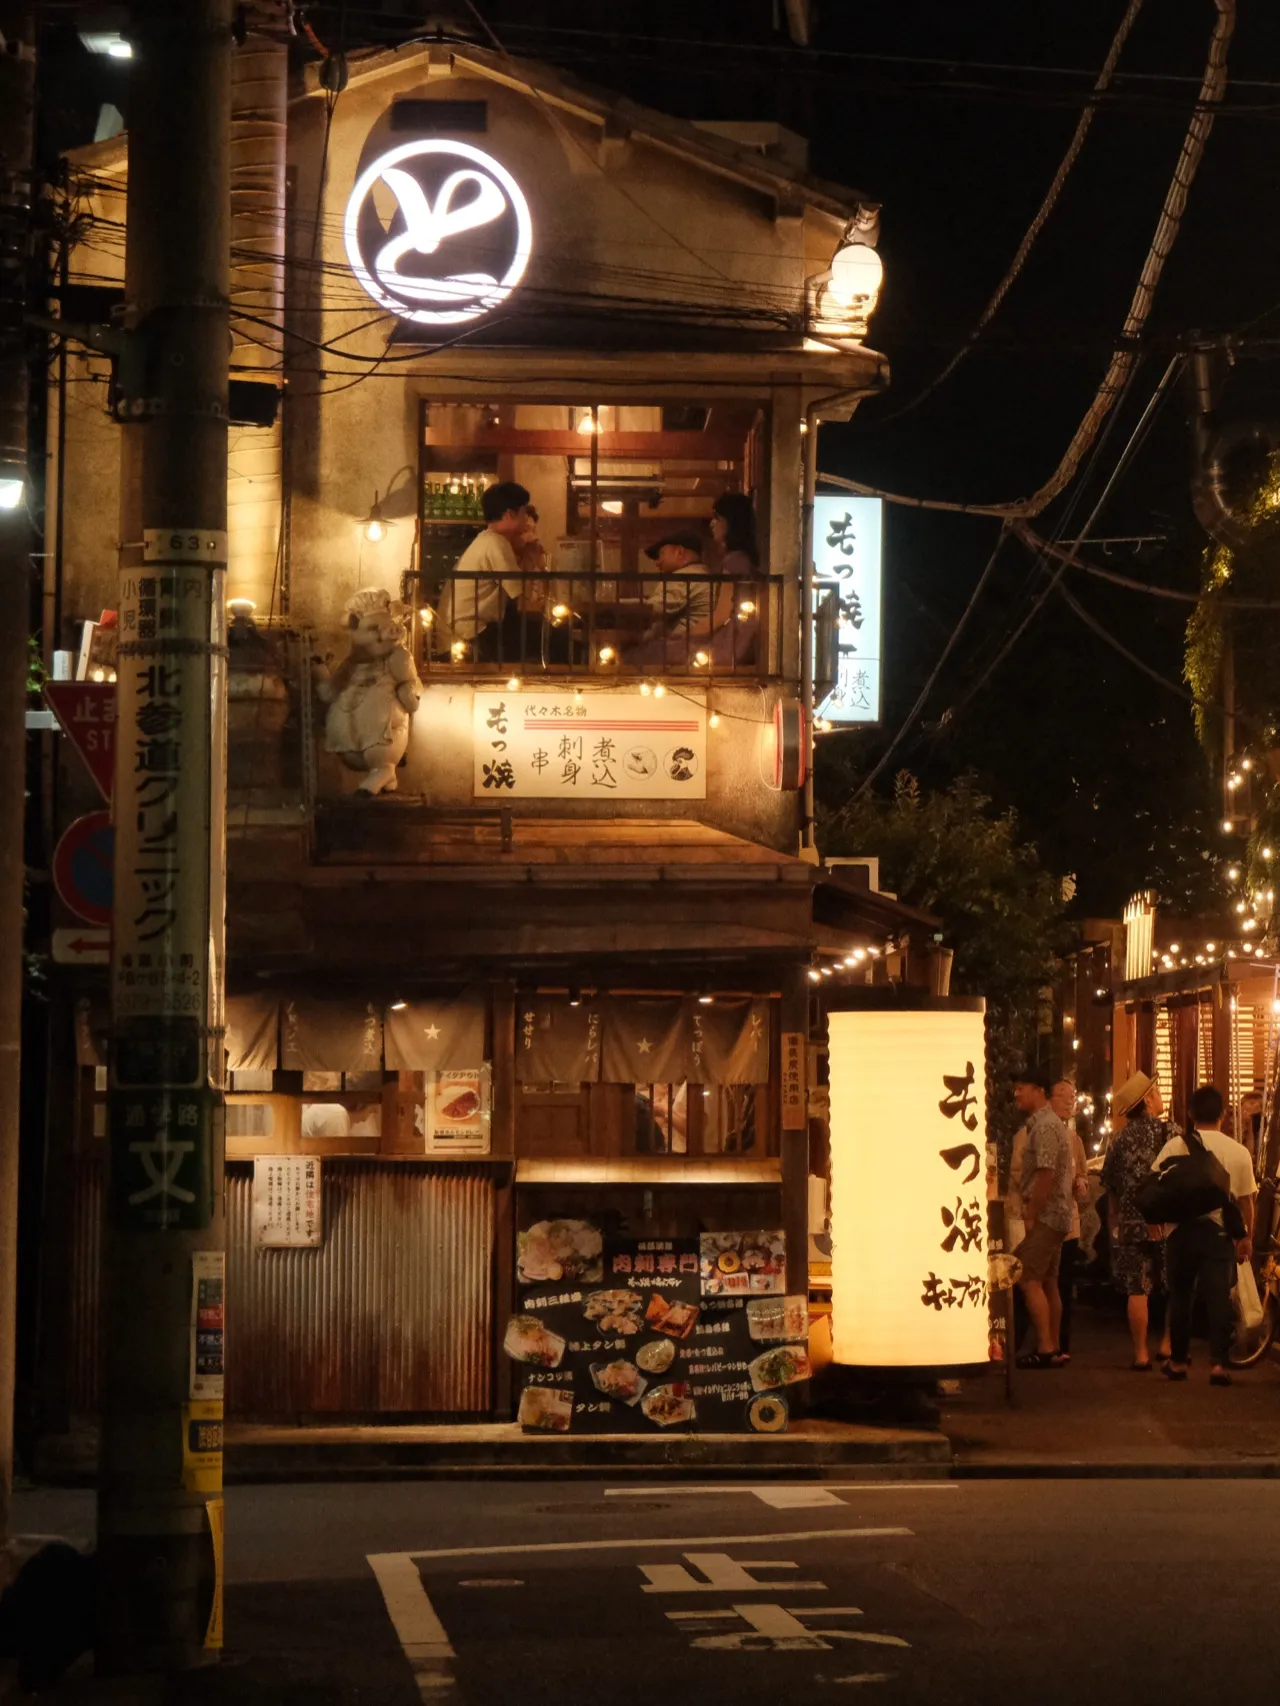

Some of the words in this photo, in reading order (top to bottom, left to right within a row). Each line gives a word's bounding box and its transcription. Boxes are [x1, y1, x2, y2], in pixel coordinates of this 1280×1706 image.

[170, 536, 200, 551] 63
[73, 697, 116, 722] 止ま
[525, 704, 588, 718] 代々木名物
[482, 701, 517, 790] もつ焼
[530, 747, 550, 776] 串
[558, 734, 584, 786] 刺身
[590, 736, 619, 790] 煮込
[134, 664, 183, 941] 北参道クリニック
[523, 1011, 537, 1051] せせり
[128, 1129, 196, 1206] 文
[937, 1060, 984, 1254] もつ焼
